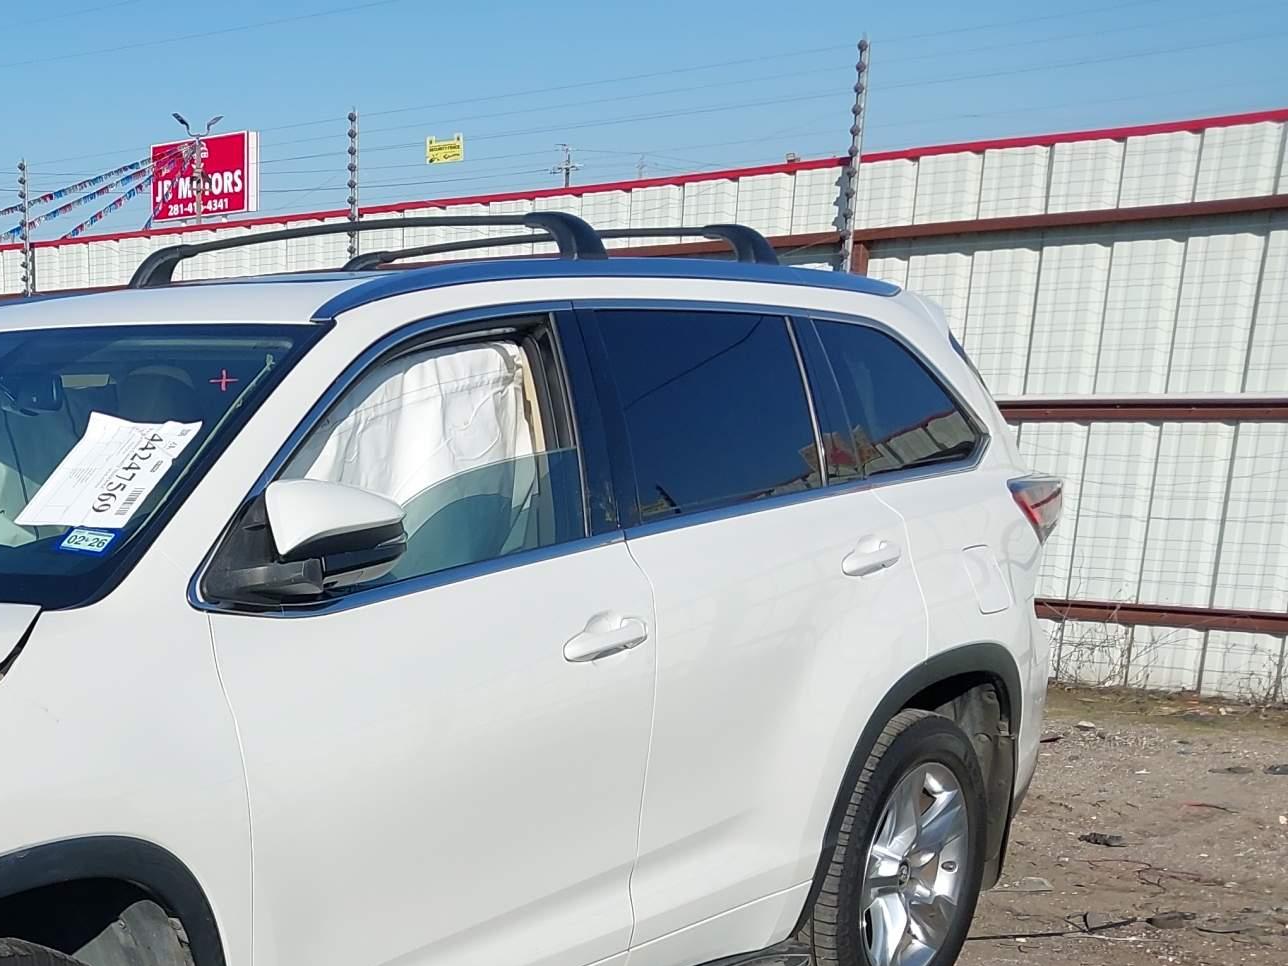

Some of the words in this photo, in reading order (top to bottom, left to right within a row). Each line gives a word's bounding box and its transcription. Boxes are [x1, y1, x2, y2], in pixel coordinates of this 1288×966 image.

[168, 198, 229, 217] 281-41-4341
[91, 432, 164, 513] 44247569
[67, 535, 86, 545] 02
[87, 537, 108, 548] 26
